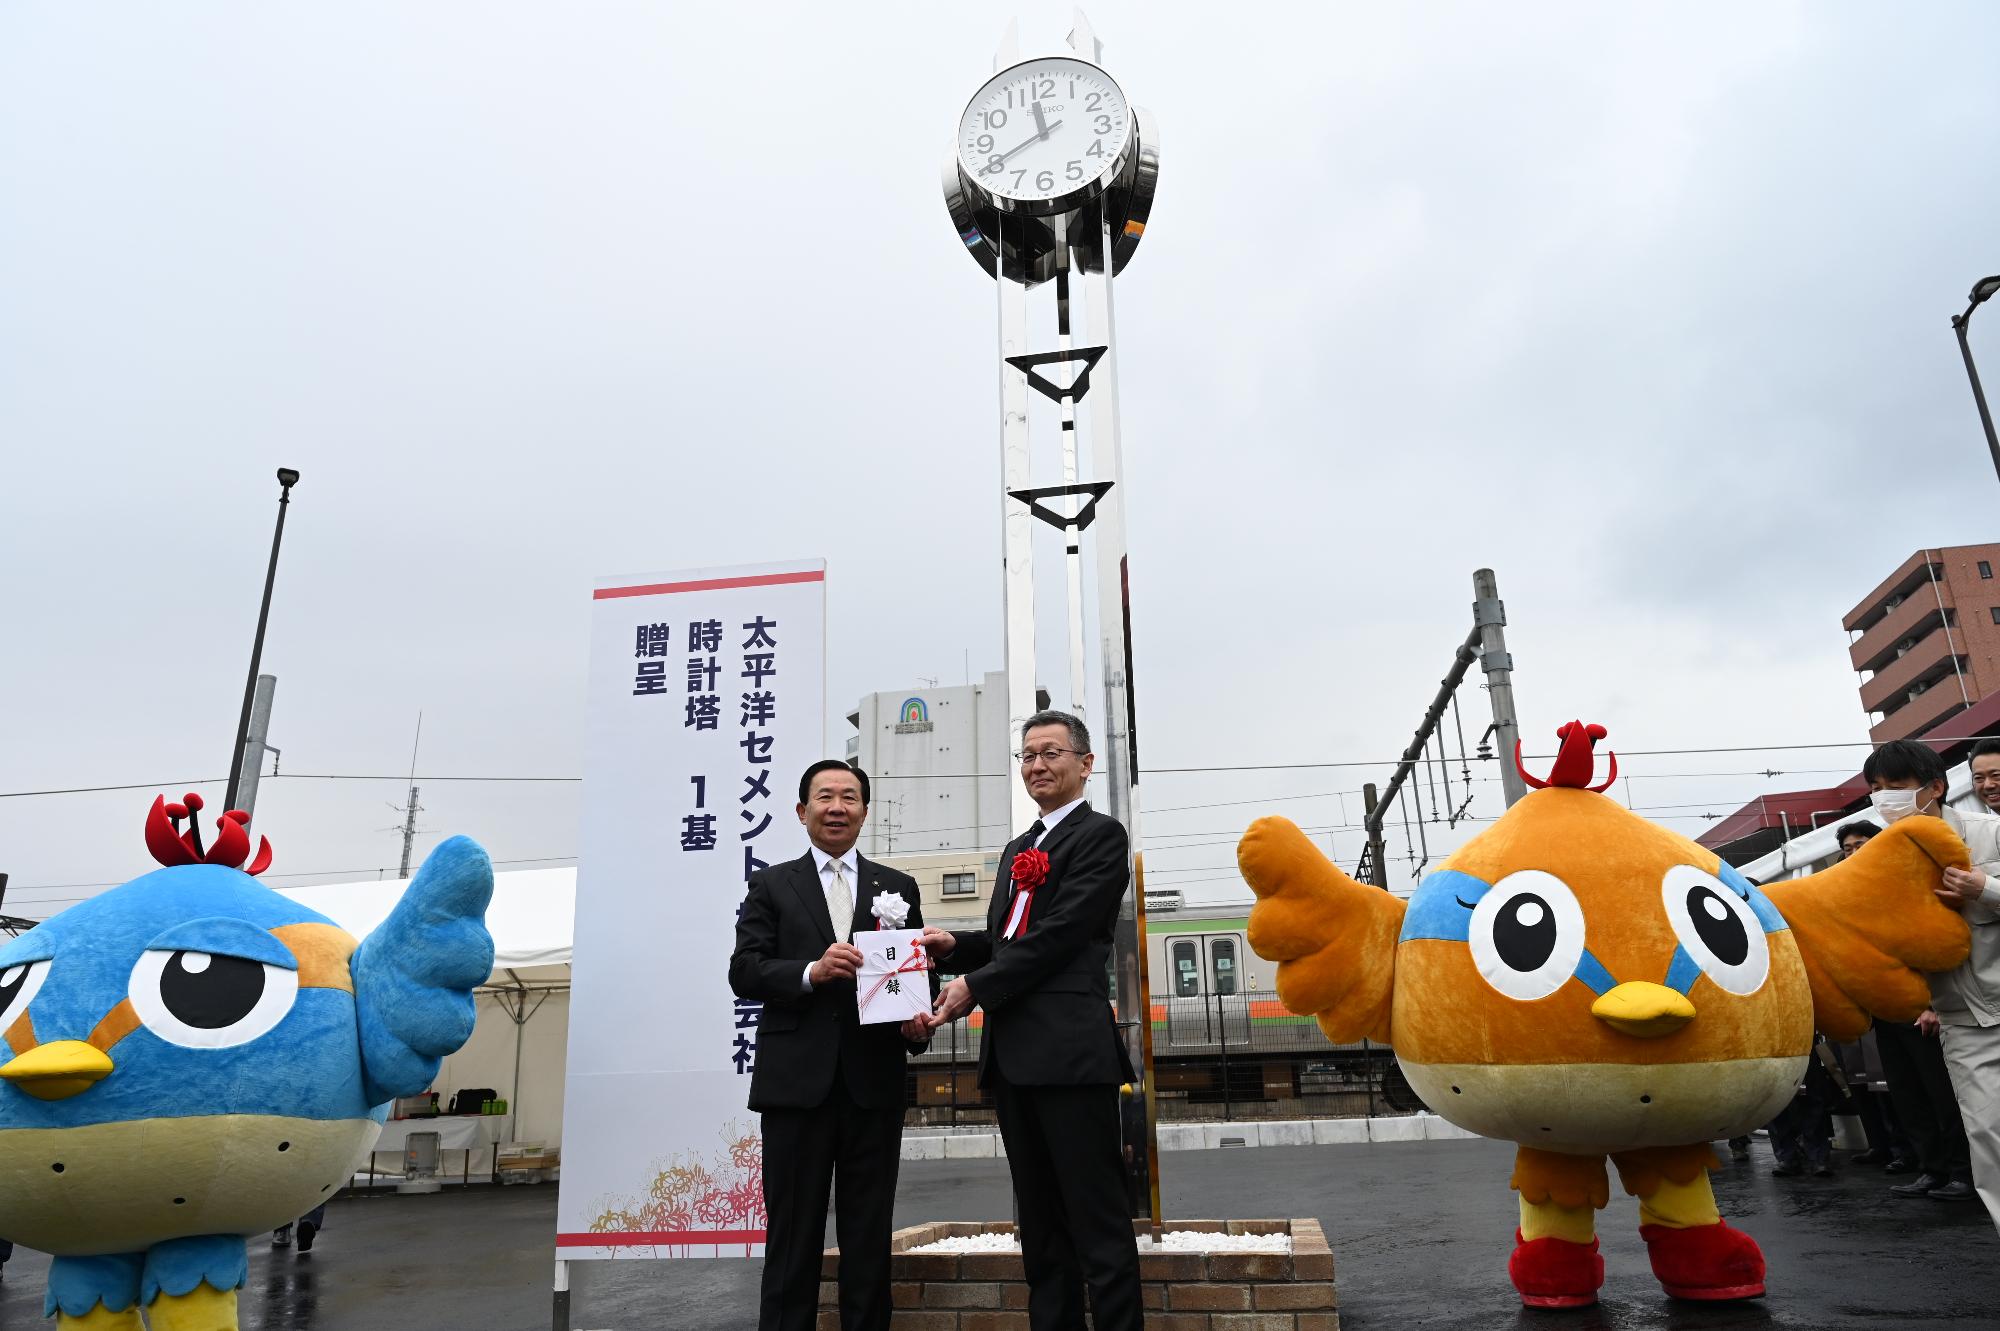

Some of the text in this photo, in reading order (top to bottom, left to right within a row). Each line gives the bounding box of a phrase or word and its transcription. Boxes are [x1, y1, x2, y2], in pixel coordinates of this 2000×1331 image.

[1007, 88, 1026, 110] 11
[1031, 78, 1057, 101] 12
[1069, 80, 1075, 100] 1
[1026, 104, 1065, 117] SIKO
[1084, 91, 1103, 113] 2
[983, 108, 1008, 131] 10
[1093, 114, 1112, 136] 3
[976, 133, 995, 155] 9
[1085, 138, 1105, 159] 4
[987, 153, 1005, 175] 8
[1065, 159, 1084, 181] 5
[1009, 168, 1028, 190] 7
[1035, 170, 1055, 192] 6
[632, 622, 670, 696] 贈呈
[680, 618, 723, 852] 時計塔 1基
[731, 615, 778, 1075] 太平洋セメント会社
